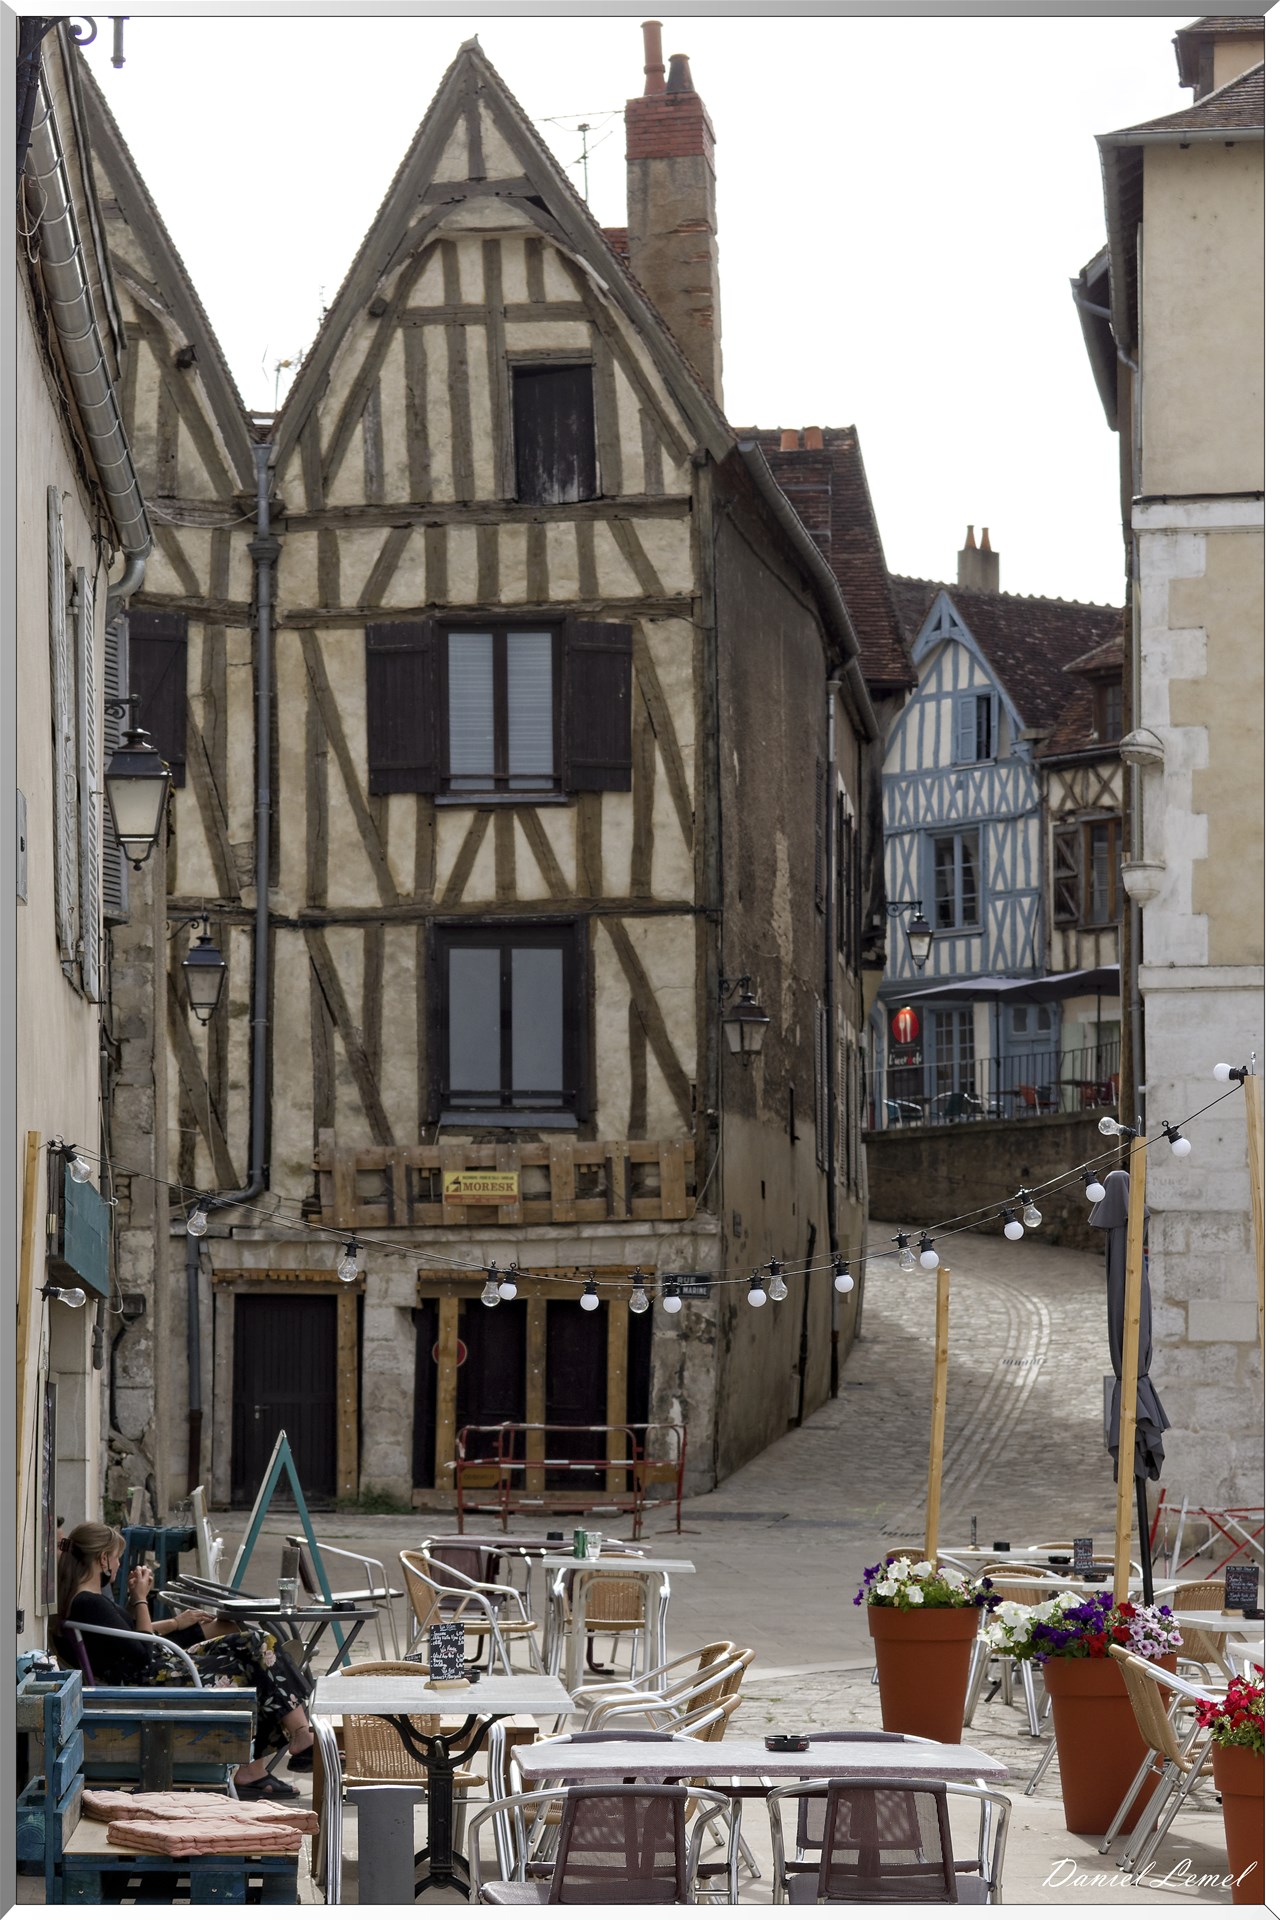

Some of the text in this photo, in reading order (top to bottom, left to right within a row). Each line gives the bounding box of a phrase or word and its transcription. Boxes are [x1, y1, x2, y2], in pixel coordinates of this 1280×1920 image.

[463, 1182, 515, 1192] MORESK
[677, 1276, 696, 1285] RUE
[682, 1286, 707, 1296] MARINE
